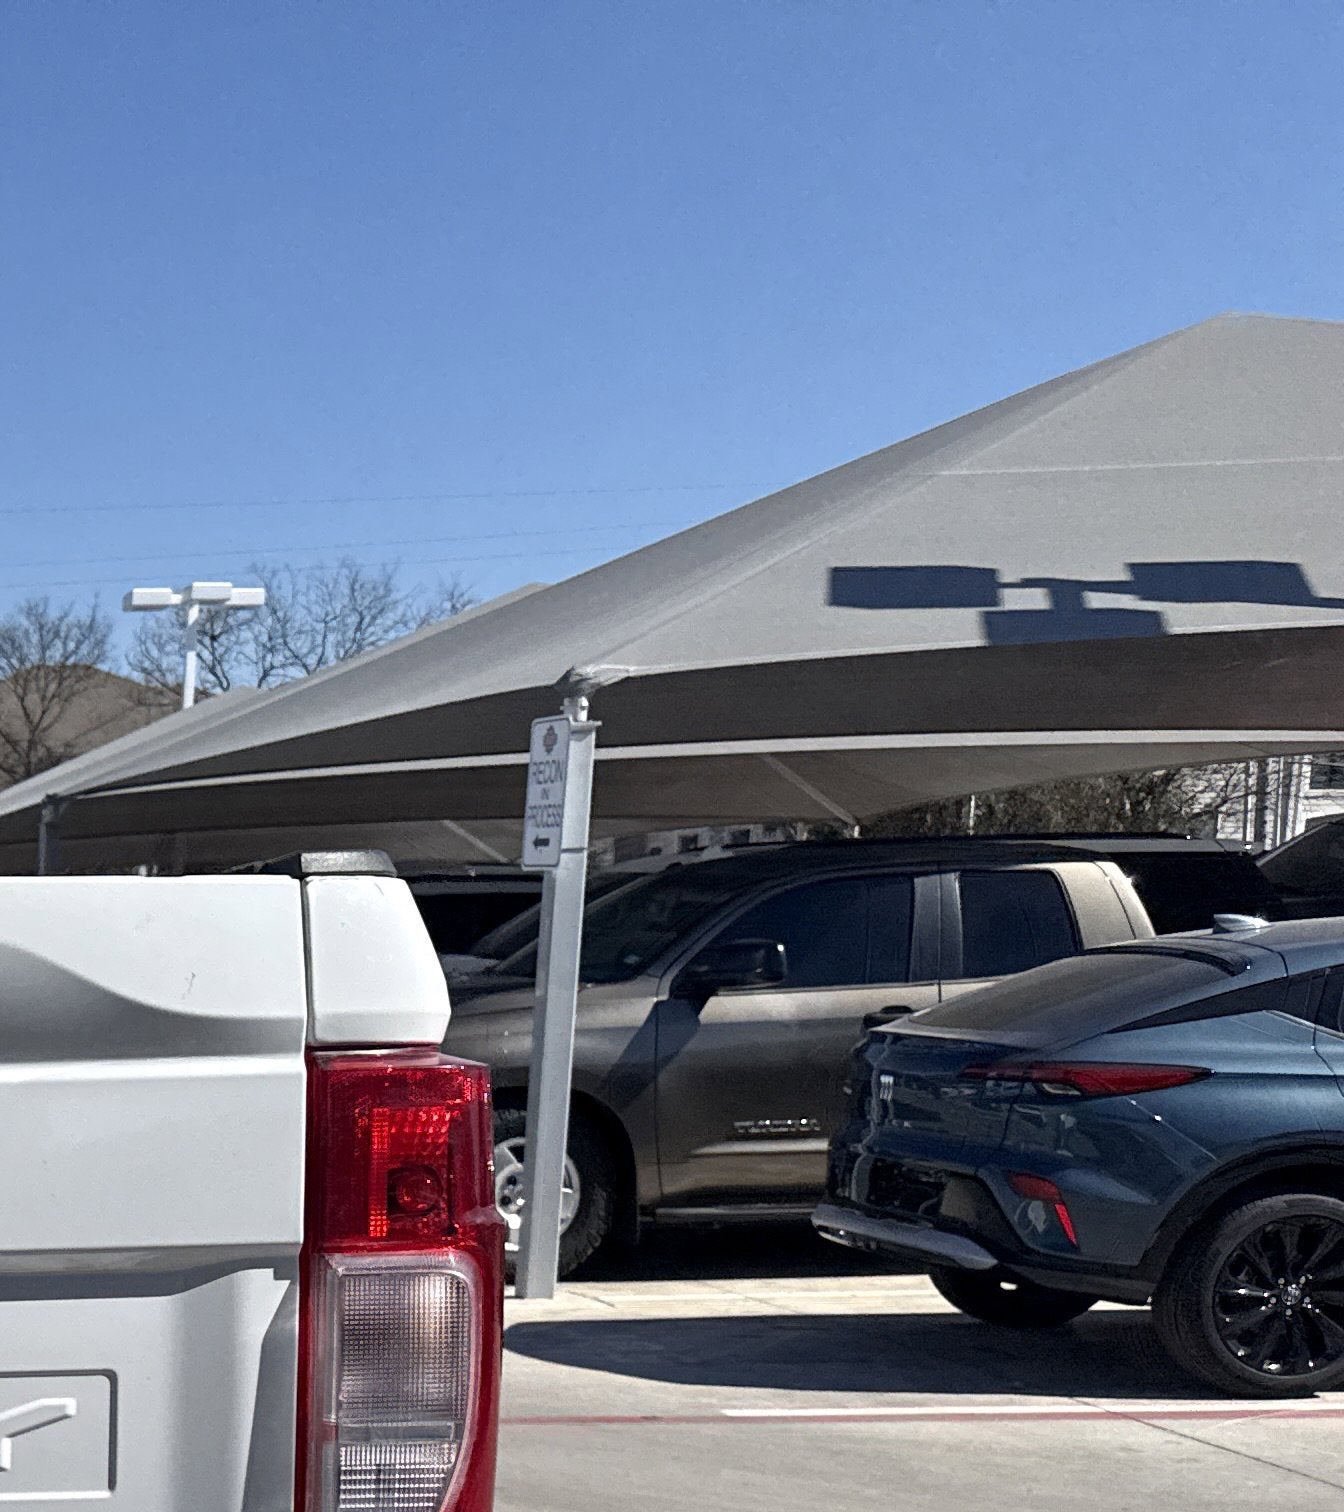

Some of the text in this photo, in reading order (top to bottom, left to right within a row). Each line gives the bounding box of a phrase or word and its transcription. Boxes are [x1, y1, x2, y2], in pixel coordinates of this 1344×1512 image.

[531, 759, 563, 785] RECON
[541, 787, 550, 800] IN
[527, 803, 562, 829] PROCESS
